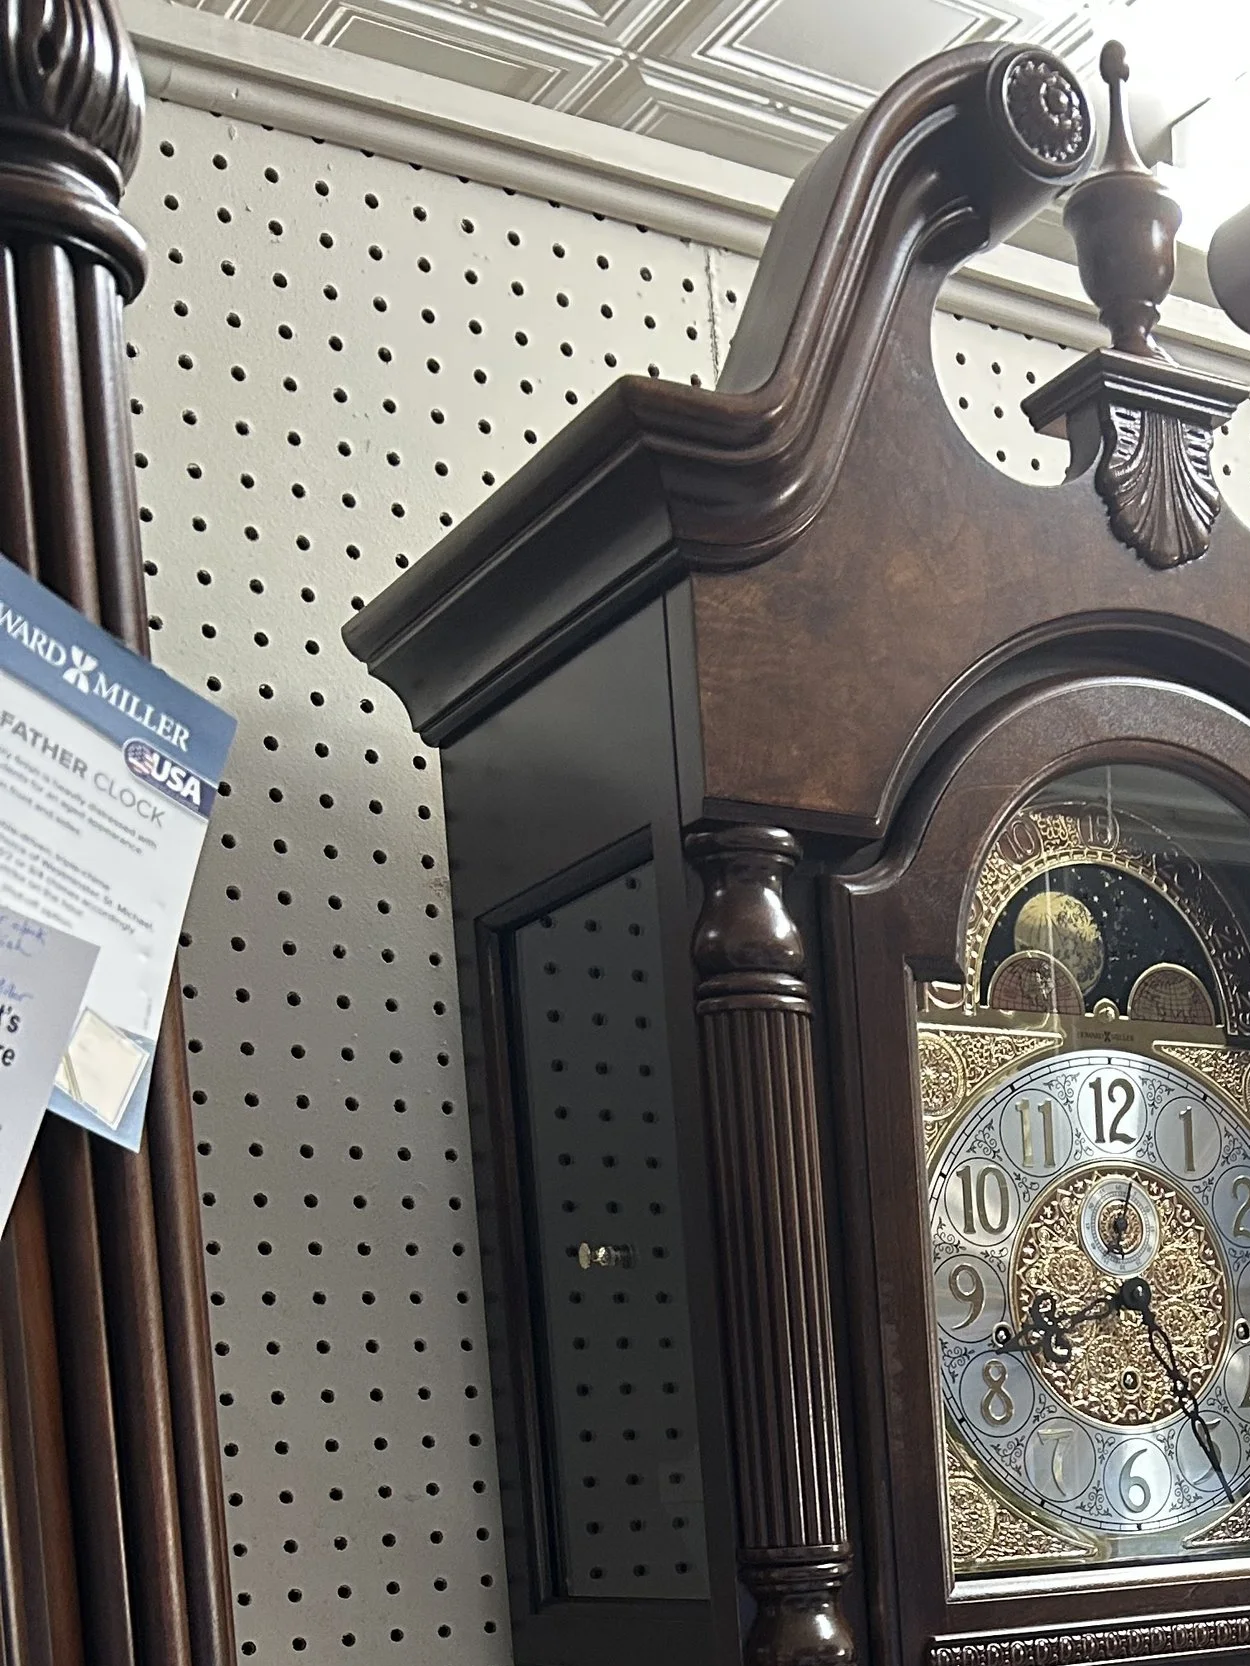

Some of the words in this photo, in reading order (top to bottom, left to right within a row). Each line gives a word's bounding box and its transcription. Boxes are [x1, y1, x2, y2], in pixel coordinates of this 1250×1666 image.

[93, 671, 190, 752] MILLER
[0, 710, 88, 780] FATHER
[93, 773, 168, 827] CLOCK
[150, 752, 201, 805] USA
[1004, 818, 1036, 861] 10
[1019, 1098, 1055, 1168] 11
[1089, 1077, 1135, 1144] 12
[1179, 1106, 1195, 1173] 1
[956, 1164, 1010, 1235] 10
[949, 1264, 985, 1331] 9
[980, 1360, 1014, 1427] 8
[1037, 1428, 1066, 1495] 7
[1121, 1447, 1152, 1513] 6
